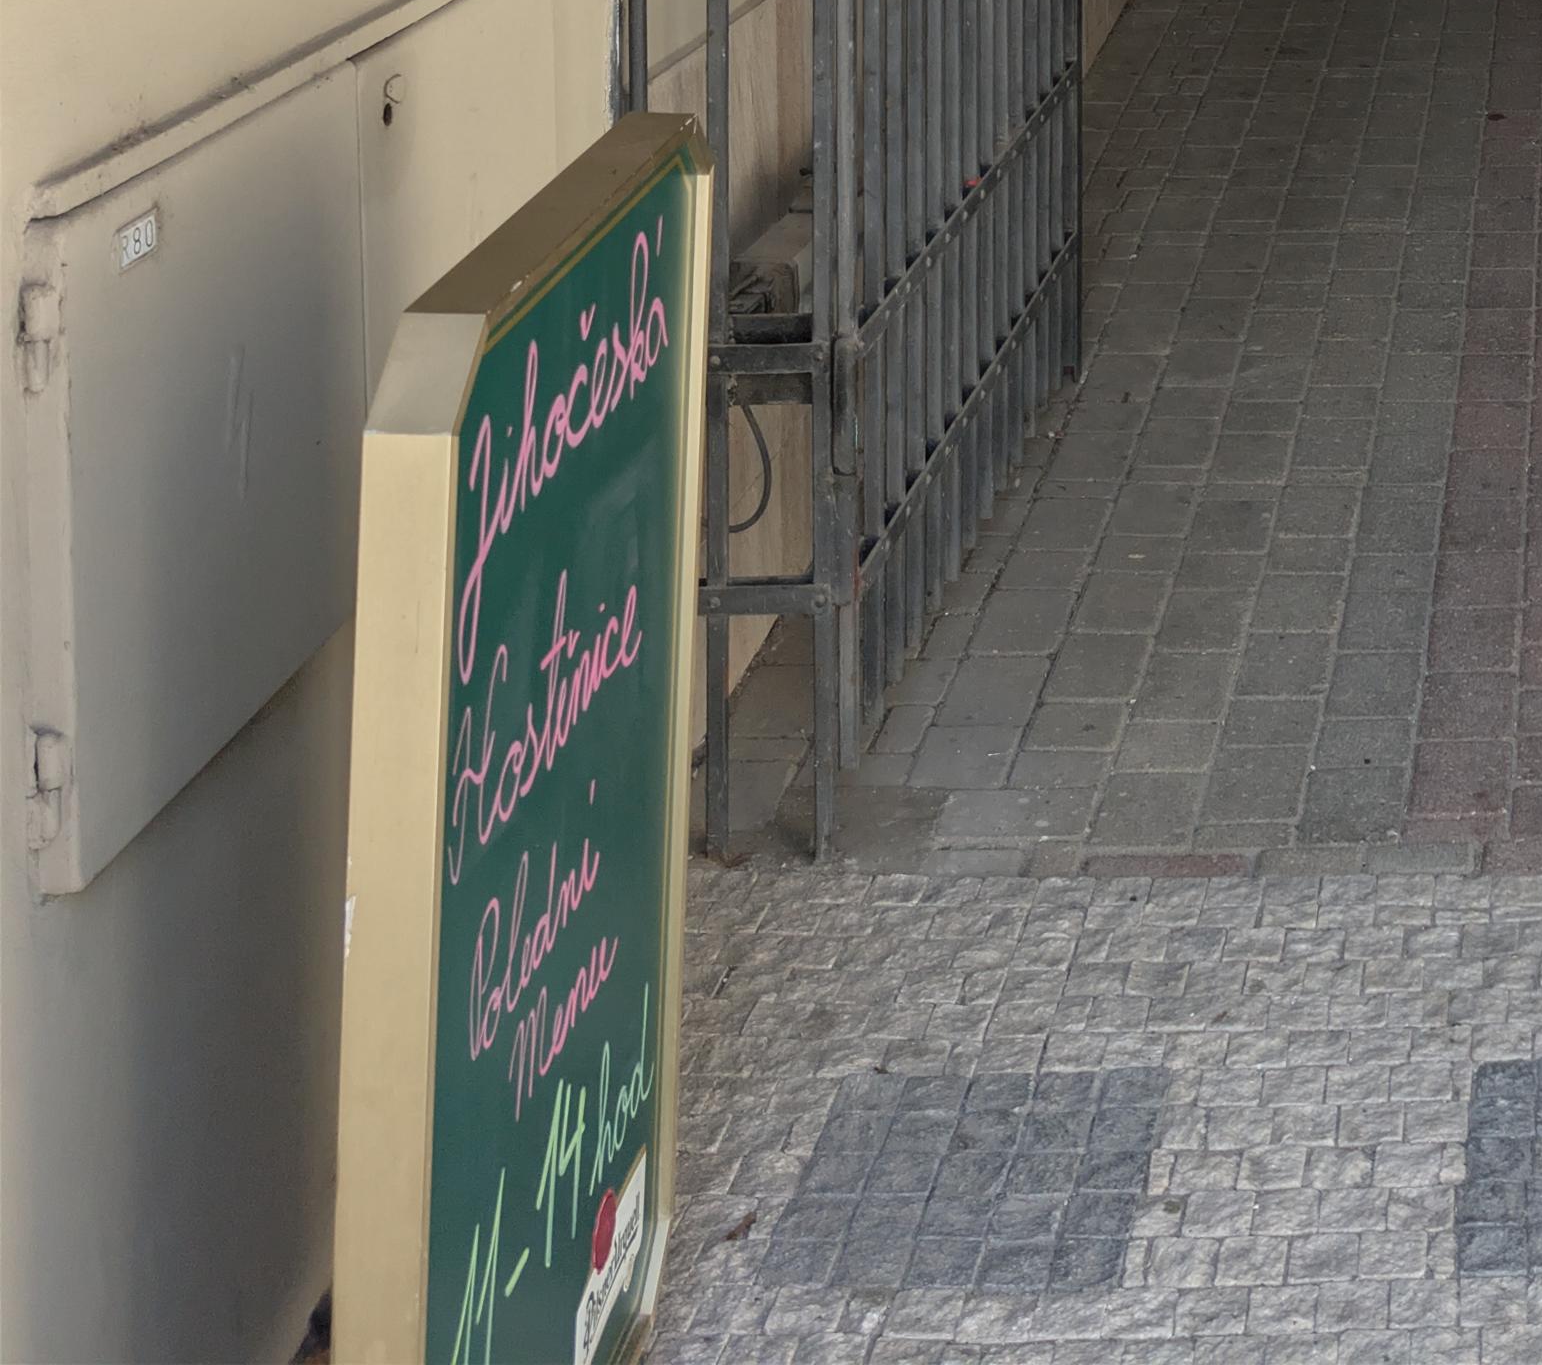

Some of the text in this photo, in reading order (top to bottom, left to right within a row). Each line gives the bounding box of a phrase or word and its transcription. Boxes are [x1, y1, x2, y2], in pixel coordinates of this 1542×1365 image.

[458, 215, 669, 685] Jihočeská
[470, 778, 600, 1061] Polední
[509, 936, 619, 1122] Menu
[589, 981, 655, 1197] hod
